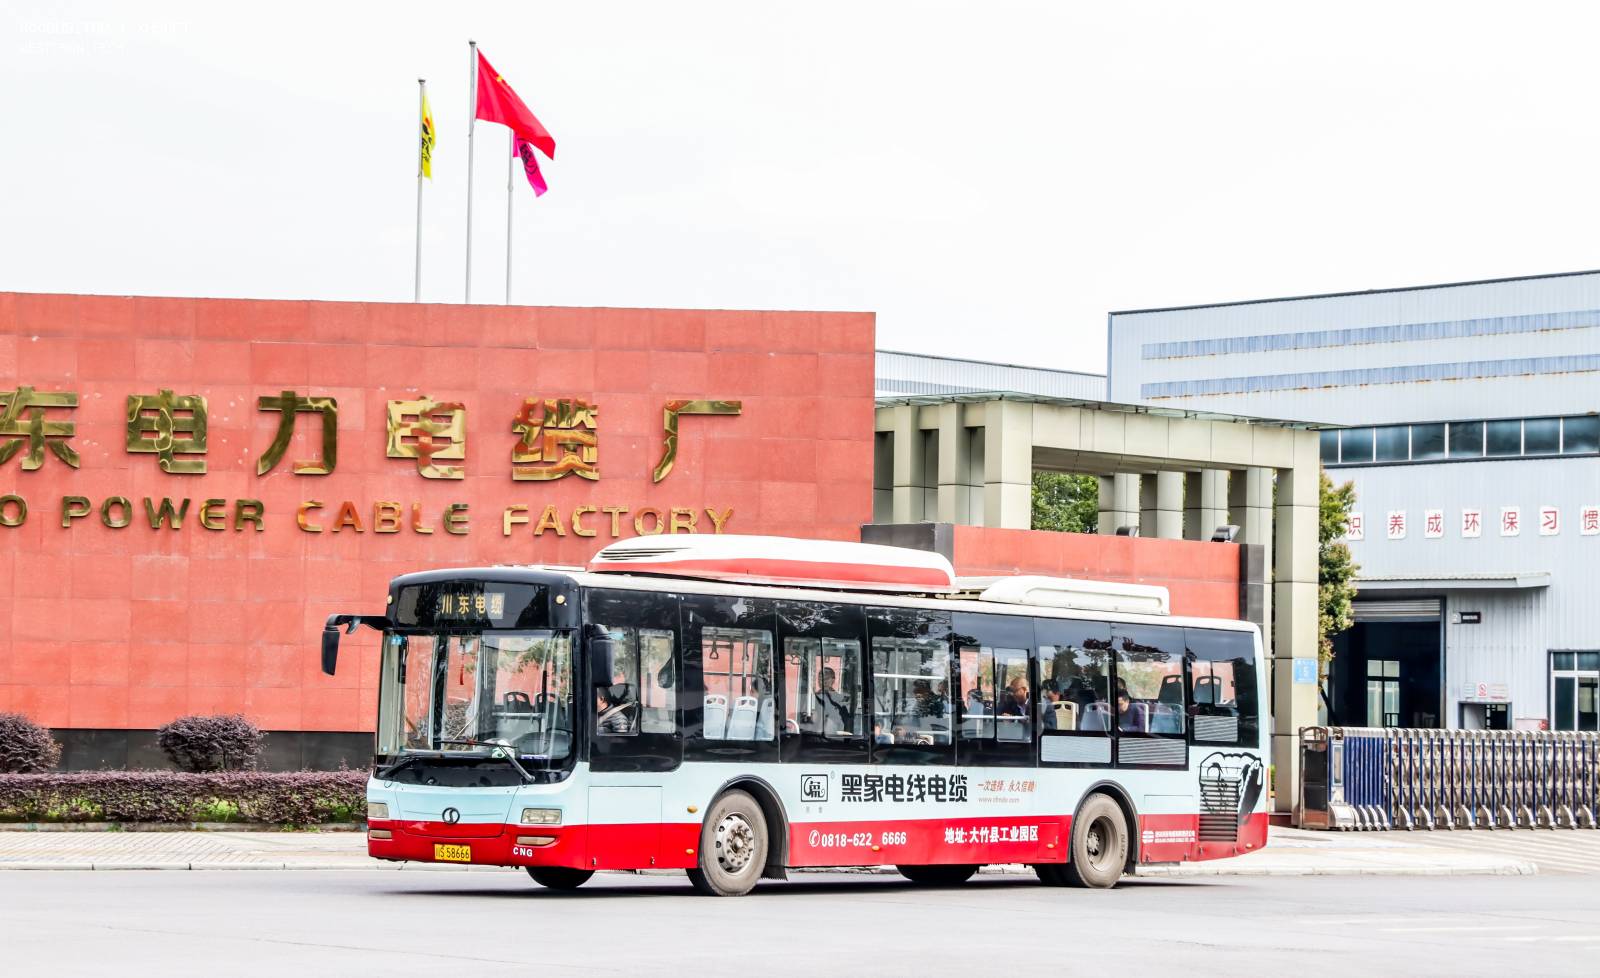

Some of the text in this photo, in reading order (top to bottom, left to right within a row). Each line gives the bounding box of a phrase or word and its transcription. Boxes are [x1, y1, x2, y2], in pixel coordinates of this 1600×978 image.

[0, 386, 742, 483] 东电力电缆厂
[62, 495, 265, 531] POWER
[297, 501, 470, 534] CABLE
[503, 503, 734, 536] FACTORY
[841, 774, 968, 802] 黑象电线电缆
[513, 847, 533, 857] CNG
[821, 832, 907, 847] 0818-622 6666
